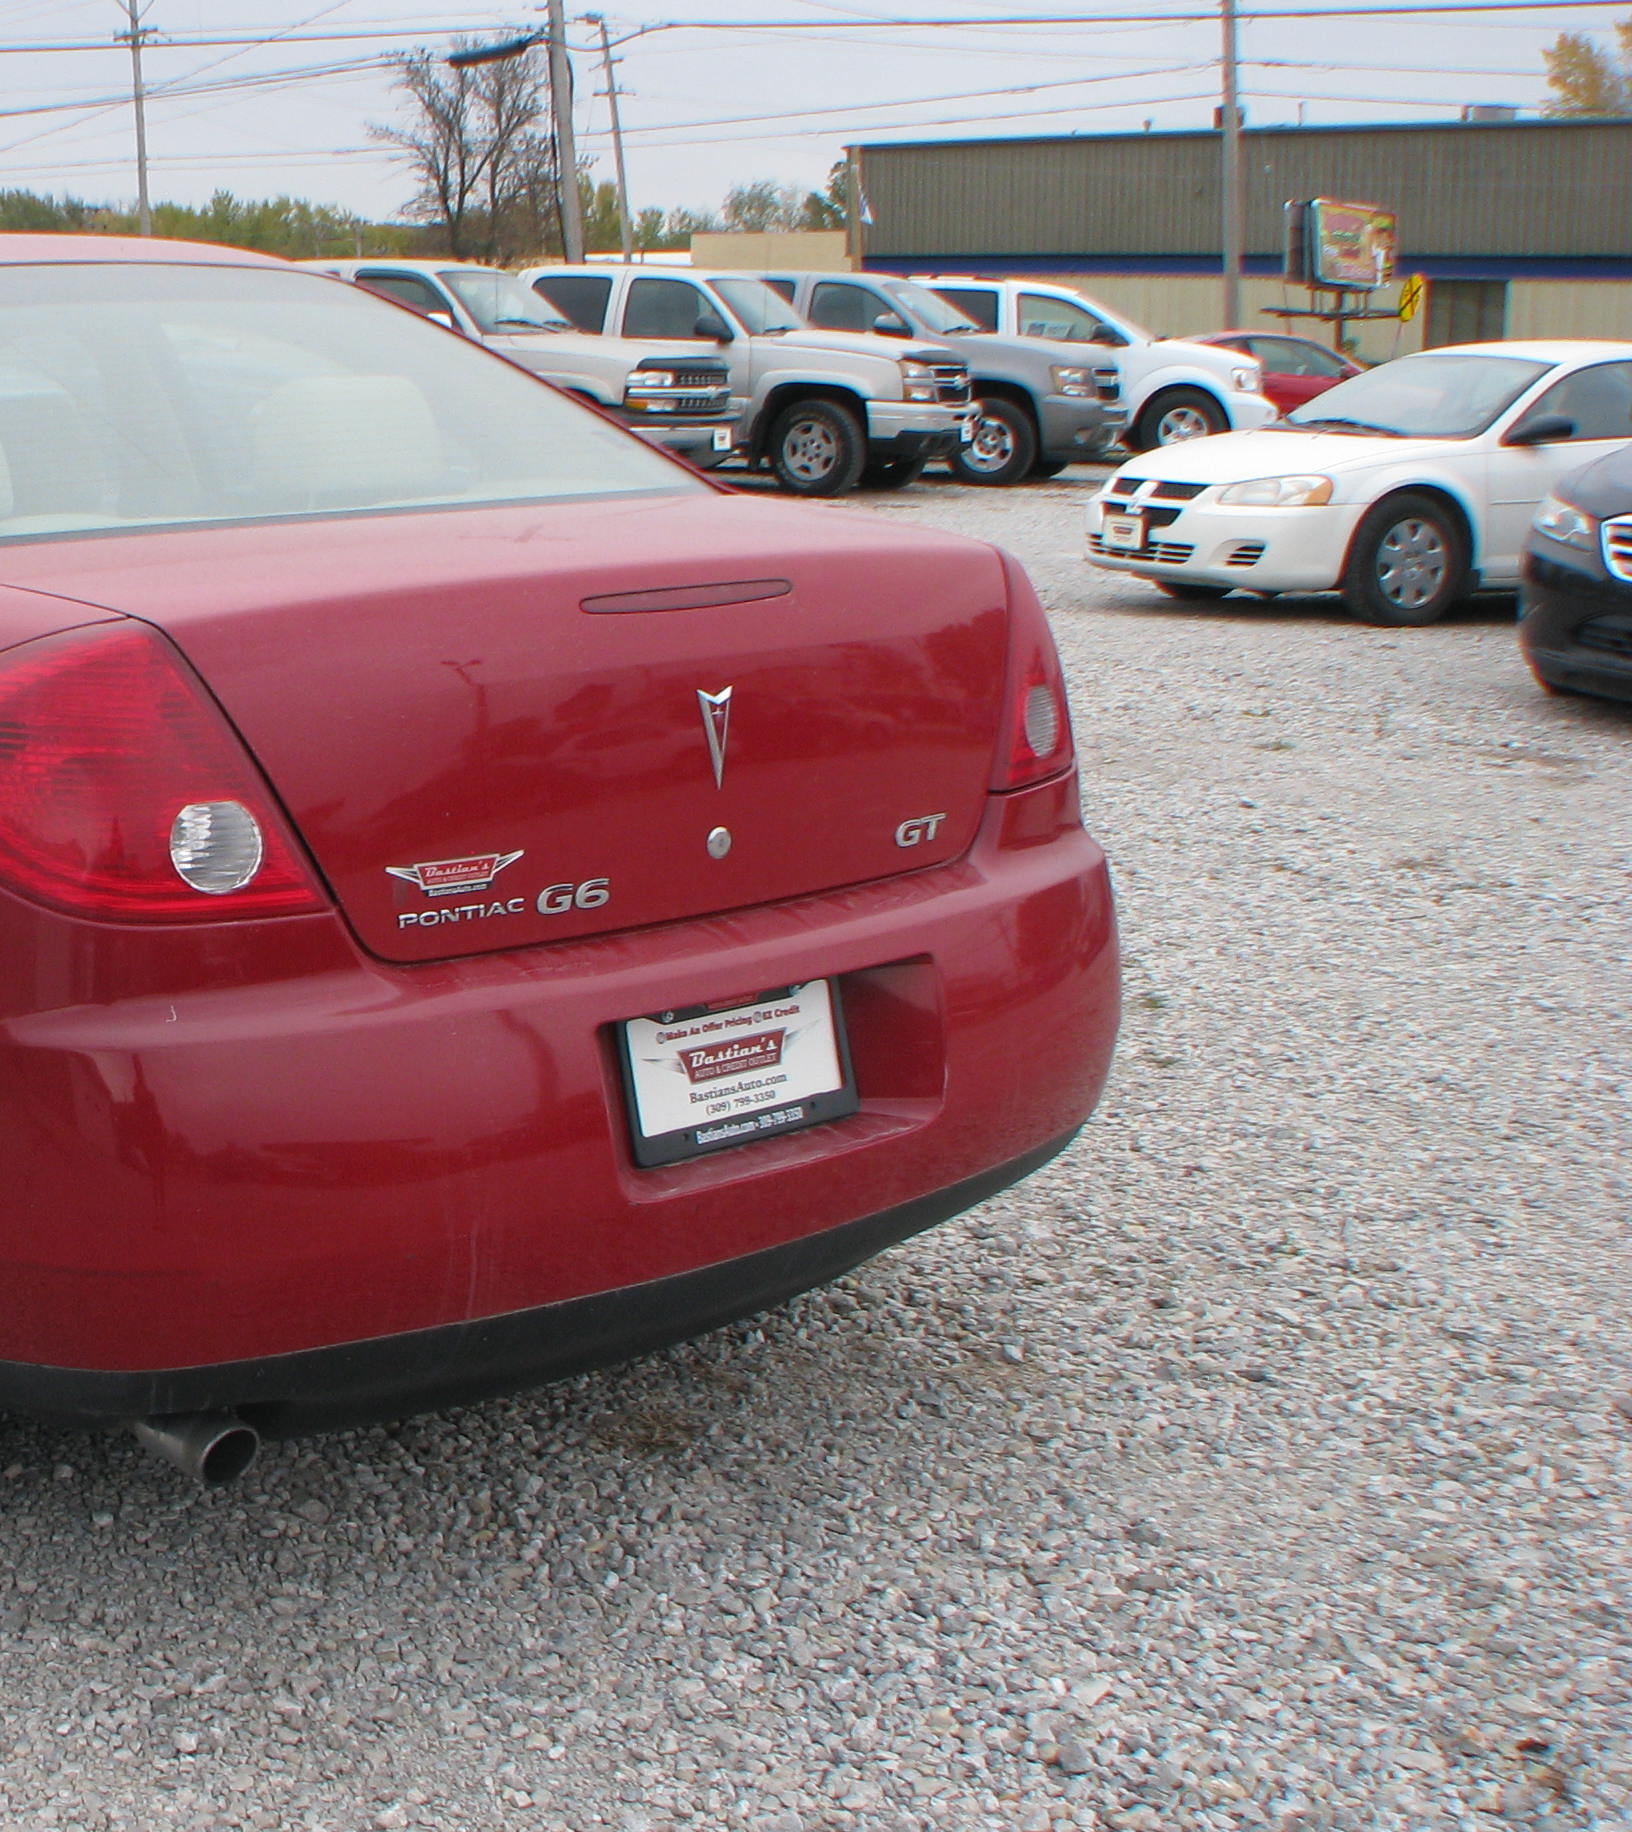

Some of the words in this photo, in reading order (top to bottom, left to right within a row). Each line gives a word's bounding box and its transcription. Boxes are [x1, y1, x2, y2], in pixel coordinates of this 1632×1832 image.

[895, 812, 946, 847] GT
[424, 860, 489, 877] Bastian's
[398, 898, 525, 929] PONTIAC
[536, 878, 610, 915] G6
[702, 1022, 723, 1032] Offer
[724, 1016, 753, 1027] Pricing
[774, 1005, 800, 1018] Credit
[688, 1037, 778, 1068] Bastian's
[689, 1074, 787, 1104] BastiansAuto.com
[706, 1101, 731, 1116] (309)
